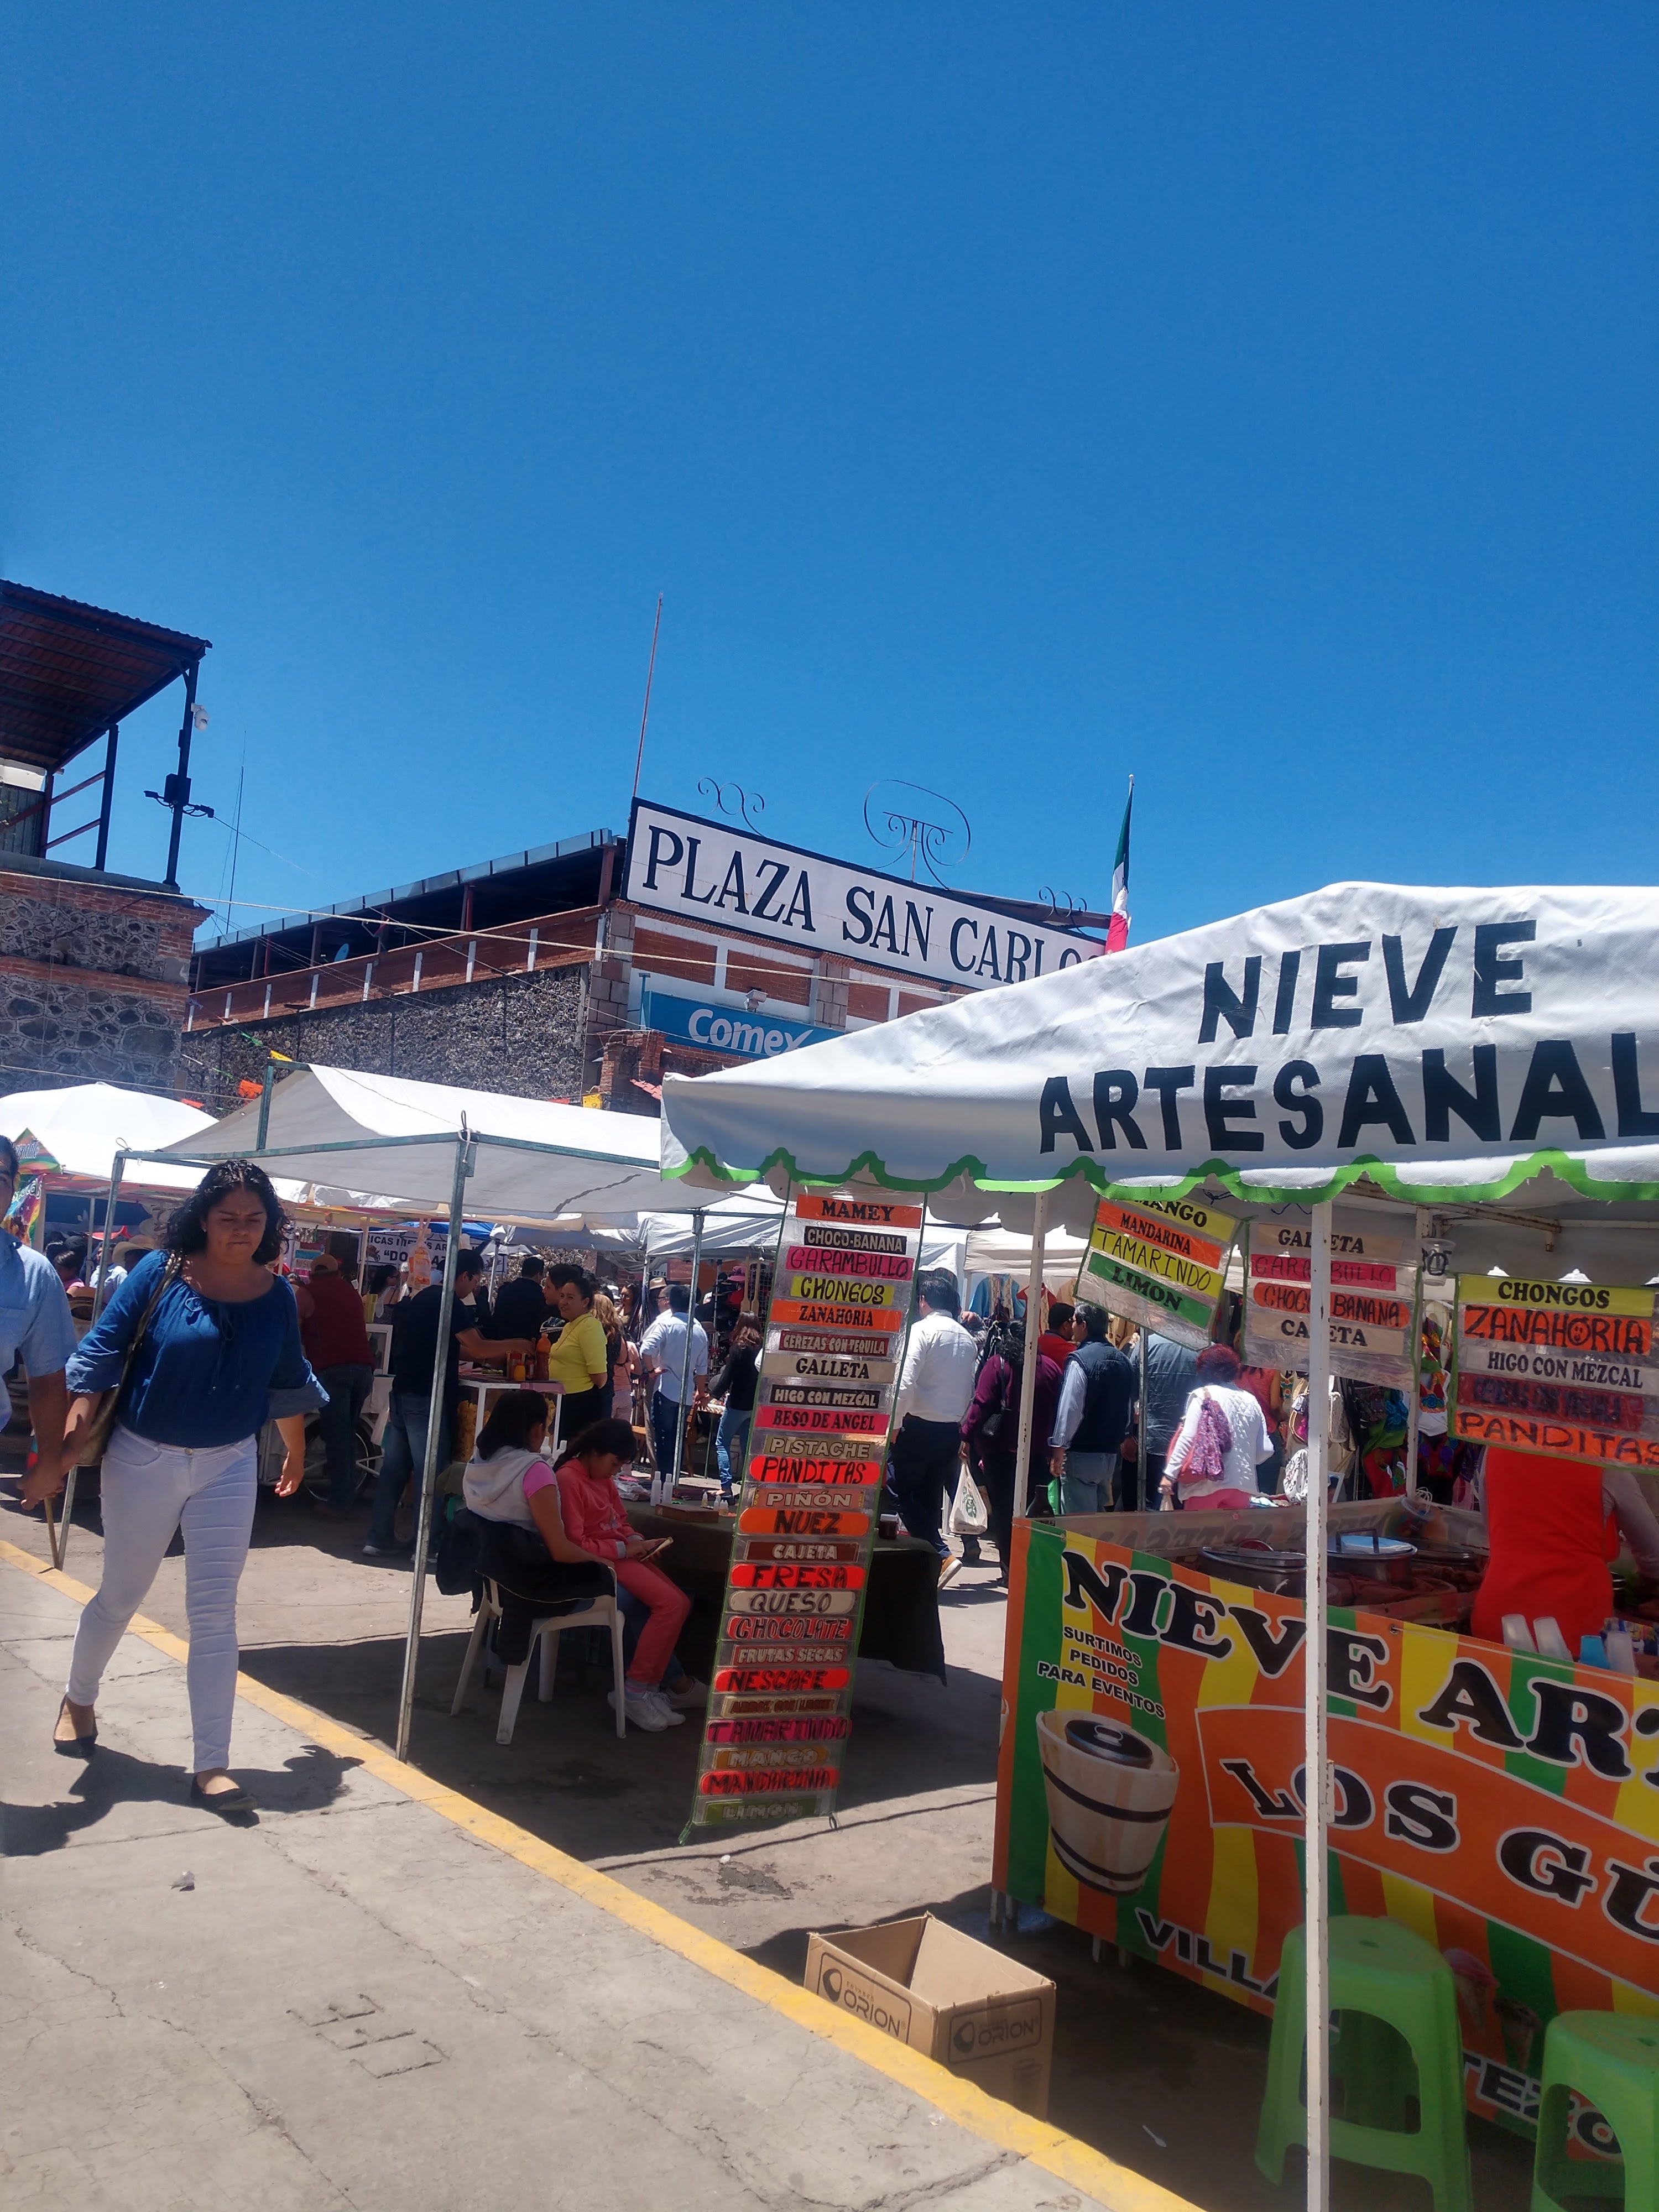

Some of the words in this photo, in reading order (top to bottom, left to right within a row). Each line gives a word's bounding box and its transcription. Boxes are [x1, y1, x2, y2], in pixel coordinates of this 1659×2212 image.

[643, 825, 816, 932] PLAZA
[843, 885, 933, 962] SAN
[1197, 919, 1536, 1044] NIEVE
[1040, 1032, 1659, 1154] ARTESANAL
[821, 1199, 894, 1222] MAMEY
[807, 1229, 902, 1252] CHOCO-BANANA
[1120, 1213, 1191, 1255] MANDARINA
[791, 1249, 909, 1277] GARAMBULLO
[1097, 1228, 1211, 1291] TAMARINDO
[1256, 1256, 1391, 1282] GARABULLO
[800, 1277, 885, 1305] CHONGOS
[1112, 1266, 1182, 1311] LIMON
[1499, 1281, 1610, 1308] CHONGOS
[799, 1305, 873, 1326] ZANAHORIA
[1333, 1295, 1399, 1327] BANANA
[1465, 1305, 1644, 1354] ZANAHORIA
[783, 1335, 827, 1350] CEREZAS
[829, 1339, 847, 1352] CON
[848, 1340, 885, 1354] TEQUILA
[796, 1359, 869, 1379] GALLETA
[1488, 1352, 1528, 1373] HIGO
[1533, 1357, 1568, 1379] CON
[1572, 1361, 1642, 1388] MEZCAL
[774, 1389, 804, 1403] HIGO
[807, 1391, 829, 1404] CON
[832, 1392, 877, 1406] MEZCAL
[774, 1410, 807, 1427] BESO
[813, 1412, 828, 1427] DE
[833, 1414, 874, 1430] ANGEL
[770, 1439, 870, 1459] PISTACHE
[762, 1457, 866, 1484] PANDITAS
[766, 1491, 852, 1507] PIÑÓN
[775, 1511, 841, 1534] NUEZ
[772, 1543, 838, 1560] CAJETA
[752, 1566, 848, 1588] FRESA
[749, 1593, 832, 1613] QUESO
[735, 1616, 849, 1639] CHOCOLATE
[1062, 1550, 1391, 1709] NIEVE
[737, 1648, 796, 1663] FRUTAS
[796, 1648, 844, 1662] SECAS
[1063, 1626, 1142, 1668] SURTIMOS
[1070, 1648, 1139, 1686] PEDIDOS
[1037, 1661, 1086, 1687] PARA
[1092, 1677, 1165, 1719] EVENTOS
[728, 1749, 818, 1767] MANGO
[1222, 1759, 1459, 1851] LOS
[844, 1989, 901, 2037] ORION
[978, 2018, 1034, 2045] ORION
